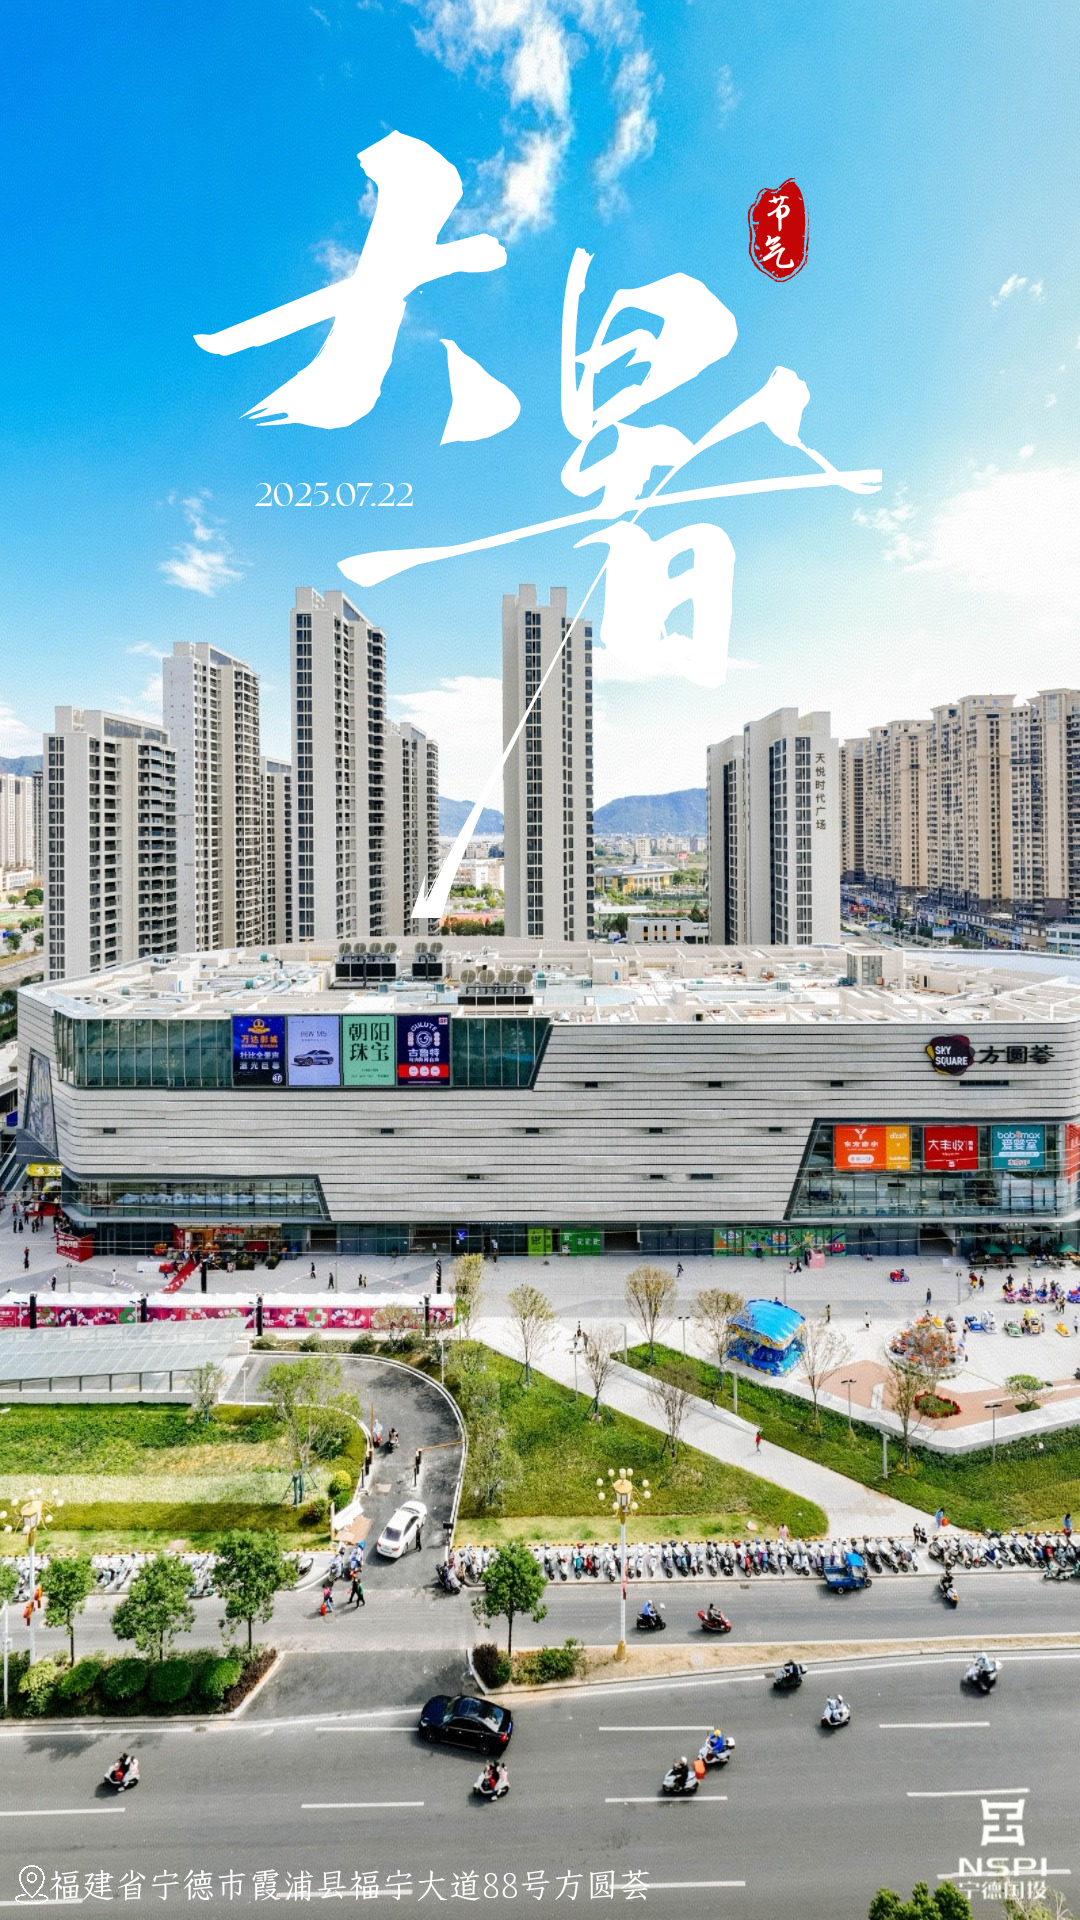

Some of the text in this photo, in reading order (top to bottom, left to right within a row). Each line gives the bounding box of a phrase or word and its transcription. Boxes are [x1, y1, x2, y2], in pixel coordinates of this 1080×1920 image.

[815, 752, 826, 830] 天悦时代广场
[348, 1022, 390, 1042] 朝阳
[241, 1034, 279, 1044] 万达影城
[239, 1051, 280, 1060] 杜比全景声
[349, 1041, 390, 1062] 珠宝
[408, 1047, 440, 1058] 古鲁特
[934, 1045, 952, 1055] SKY
[979, 1044, 1055, 1065] 方圆荟
[934, 1056, 968, 1067] SQUARE
[928, 1139, 964, 1151] 大丰收
[1001, 1139, 1038, 1151] 爱婴室
